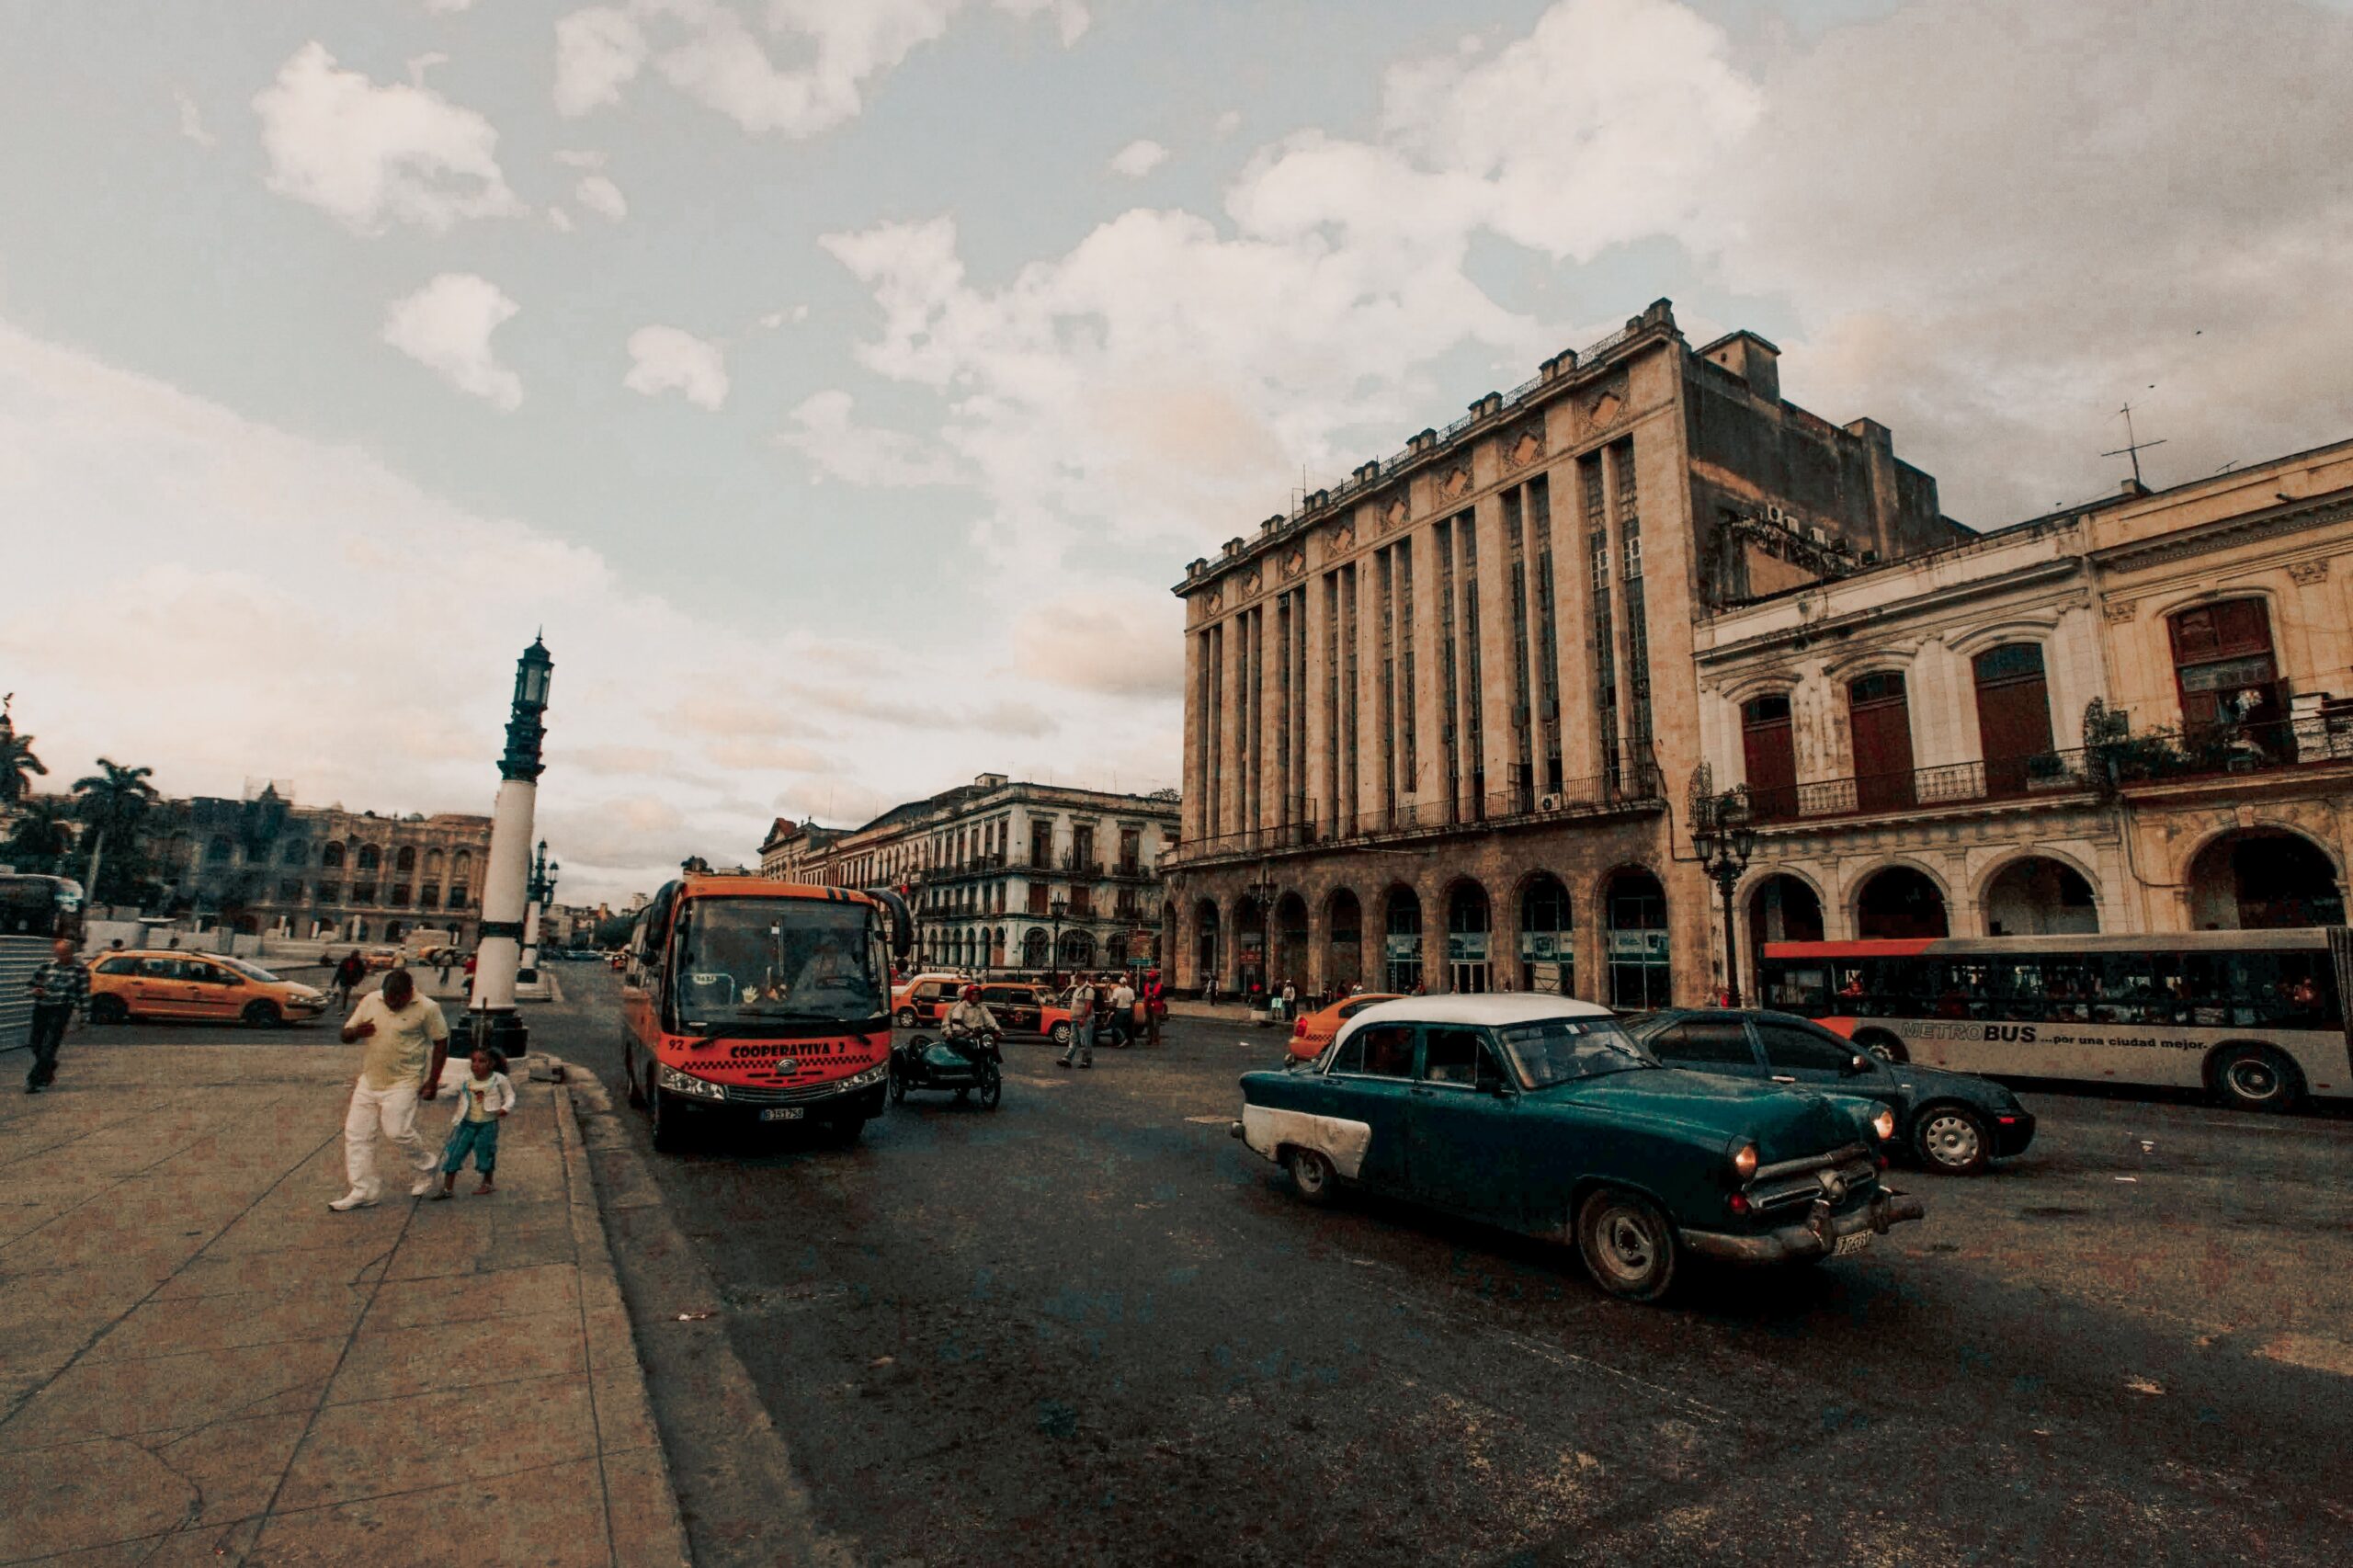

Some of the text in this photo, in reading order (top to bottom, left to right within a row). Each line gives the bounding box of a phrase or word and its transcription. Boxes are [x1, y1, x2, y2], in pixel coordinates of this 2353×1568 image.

[1901, 1022, 2037, 1043] METROBUS
[2079, 1037, 2105, 1046] una
[2109, 1037, 2156, 1048] ciudad
[2161, 1039, 2208, 1051] mejor.
[668, 1040, 685, 1051] 92
[731, 1042, 845, 1058] COOPERATIVA 2
